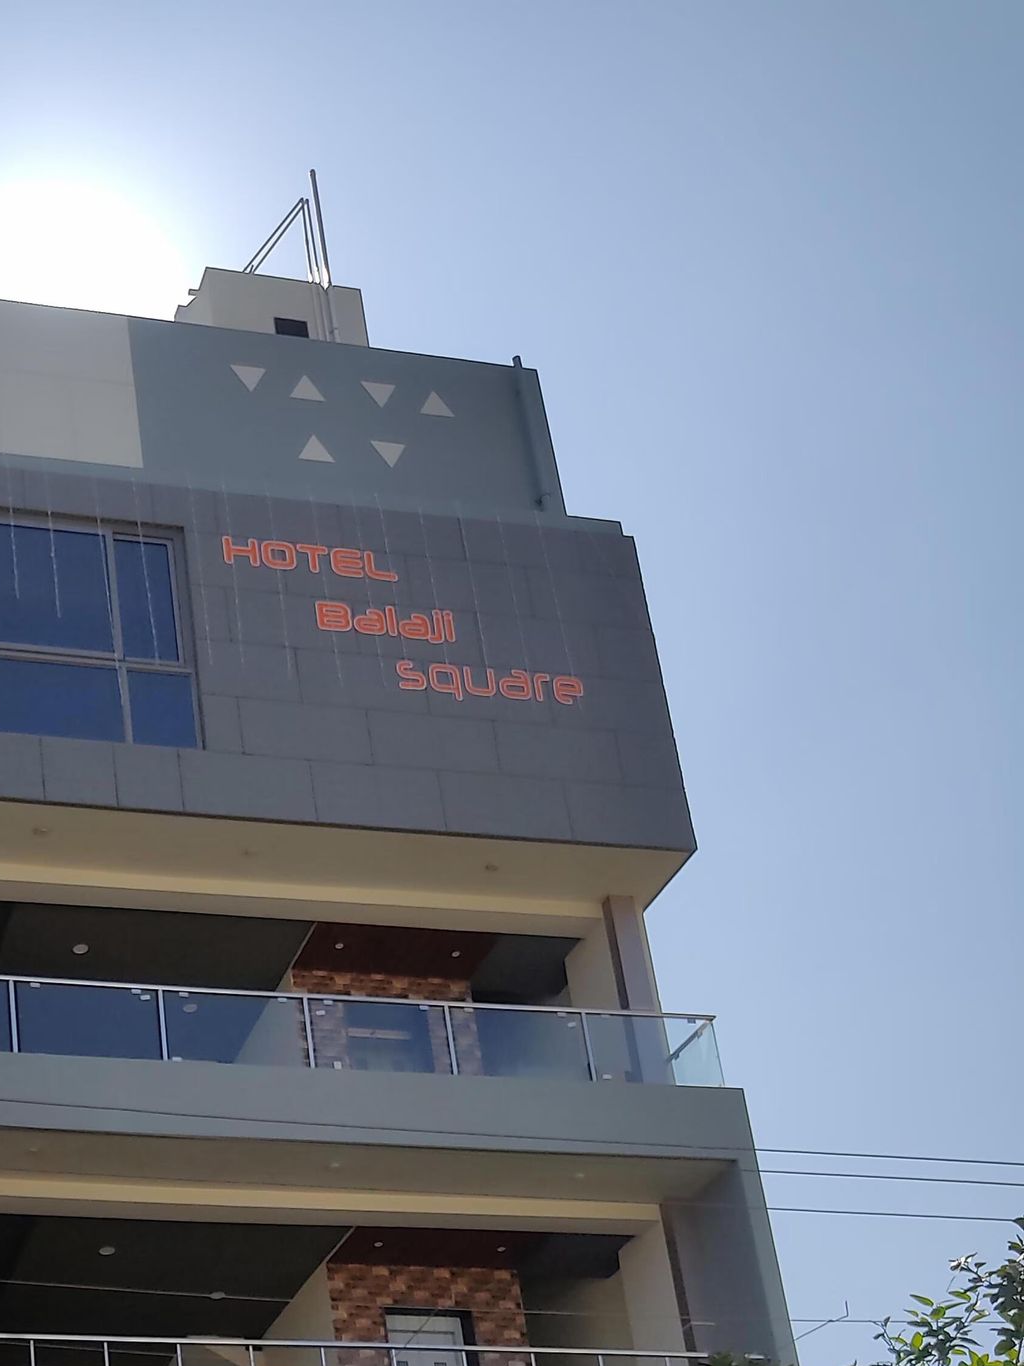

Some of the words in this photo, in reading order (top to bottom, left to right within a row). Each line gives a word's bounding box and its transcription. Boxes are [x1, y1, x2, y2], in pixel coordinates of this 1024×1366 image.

[222, 536, 398, 582] HOTEL
[315, 600, 456, 644] Balaji
[396, 660, 584, 705] square
